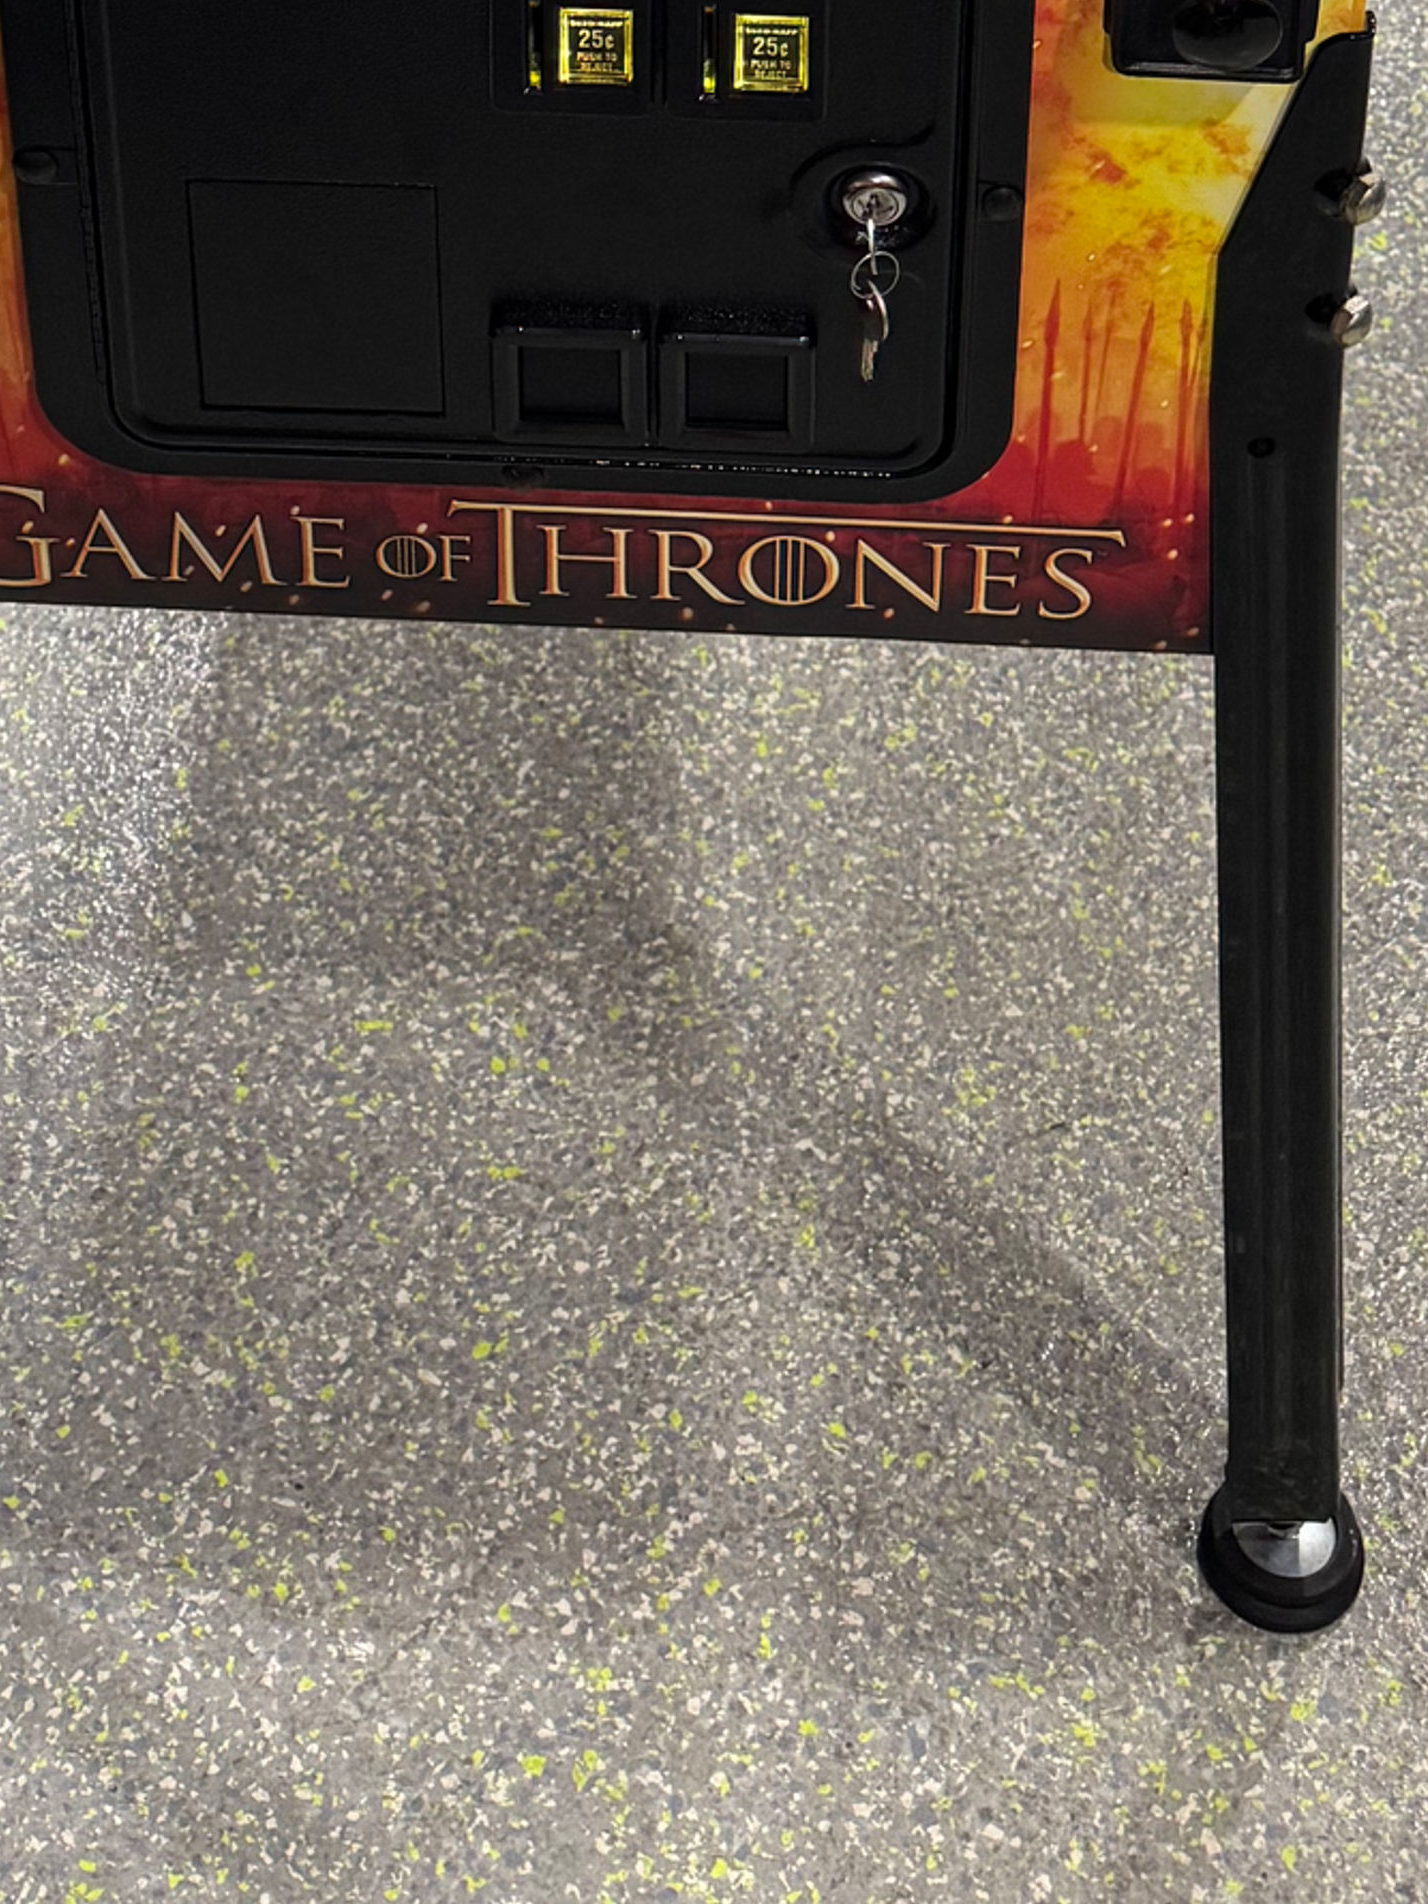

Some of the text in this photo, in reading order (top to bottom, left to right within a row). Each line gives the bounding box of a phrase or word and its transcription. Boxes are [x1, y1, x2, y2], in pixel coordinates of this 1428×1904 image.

[578, 29, 616, 49] 25¢
[752, 36, 790, 57] 25¢
[576, 51, 618, 63] PUSH TO
[750, 59, 791, 70] PUSH TO
[375, 533, 473, 583] OF
[447, 499, 1125, 622] THRONES
